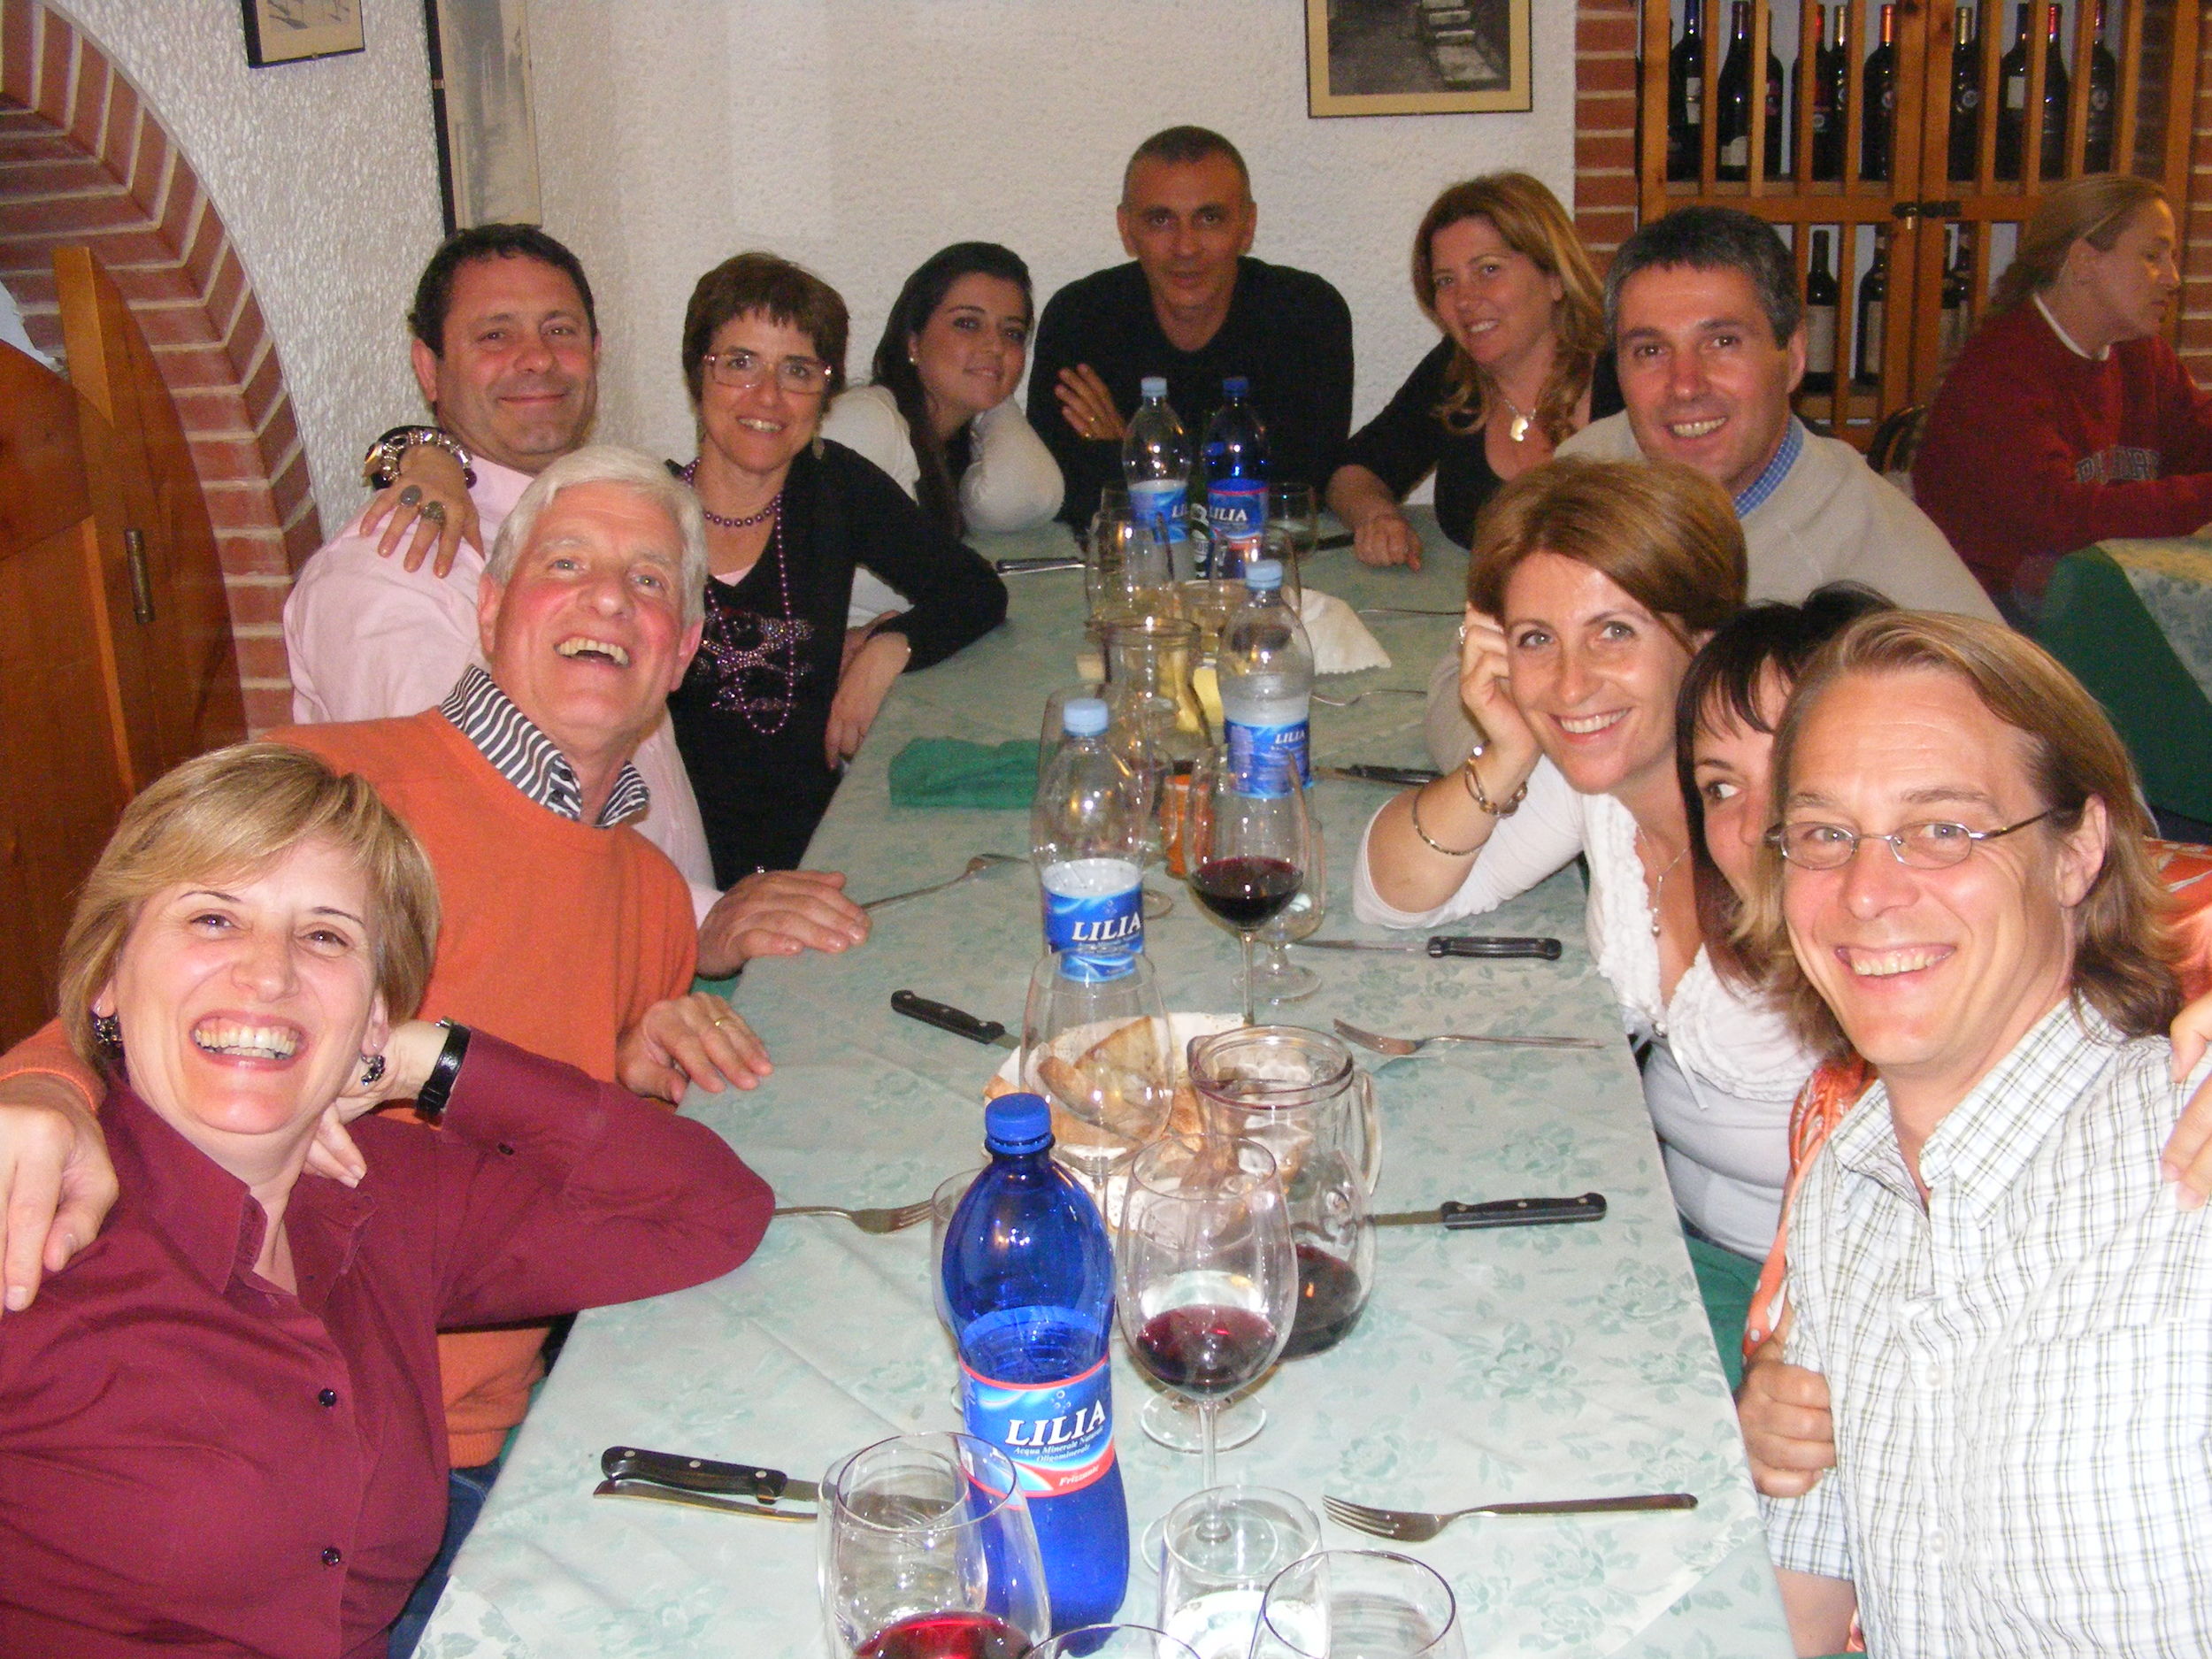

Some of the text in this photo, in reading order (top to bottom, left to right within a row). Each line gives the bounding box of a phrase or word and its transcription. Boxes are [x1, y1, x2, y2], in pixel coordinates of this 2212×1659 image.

[1071, 911, 1141, 941] LILIA
[1005, 1399, 1106, 1446] LILIA
[1014, 1447, 1041, 1457] Acqua
